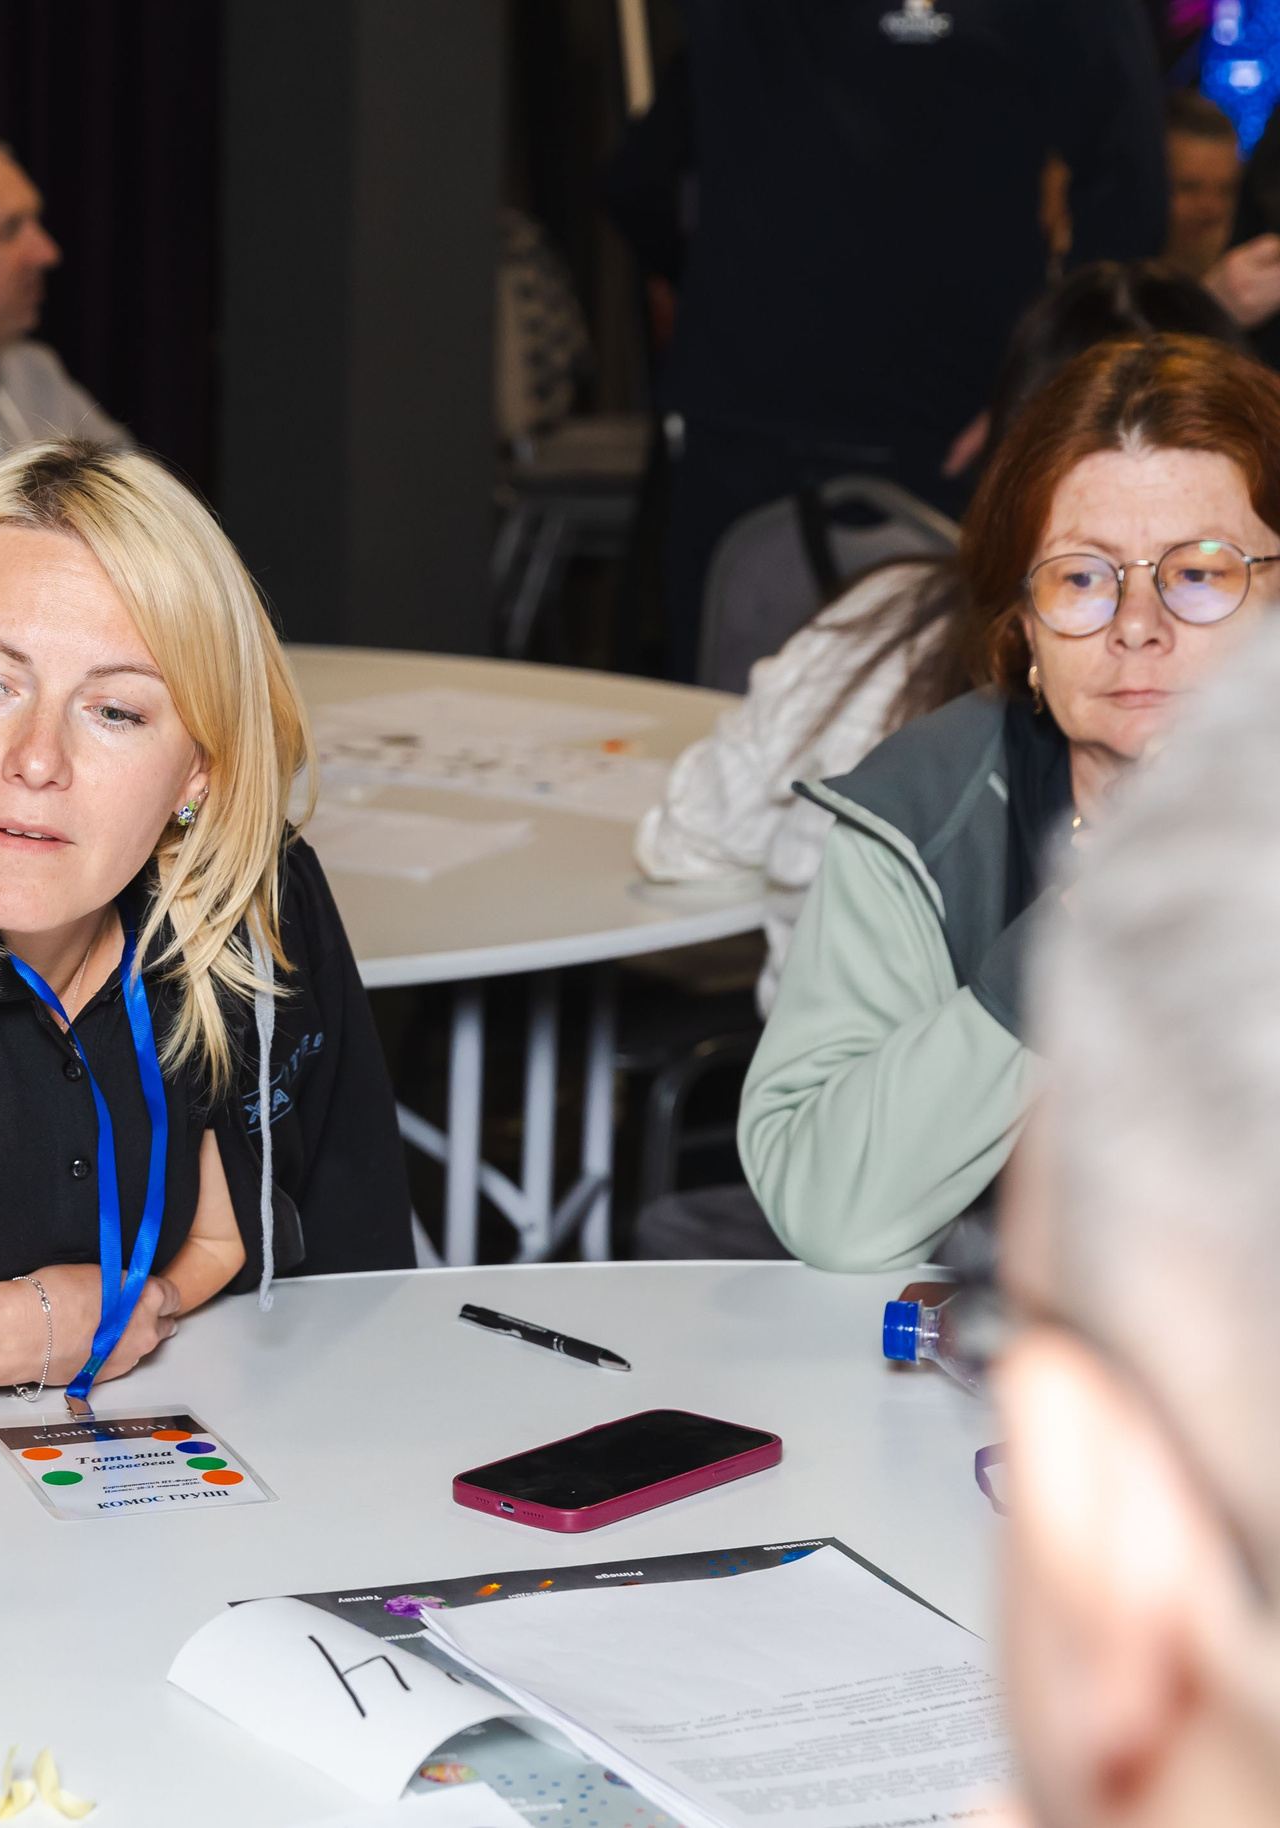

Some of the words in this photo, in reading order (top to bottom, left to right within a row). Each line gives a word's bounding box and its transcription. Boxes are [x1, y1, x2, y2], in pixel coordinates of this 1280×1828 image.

[108, 1425, 125, 1433] IT
[131, 1424, 167, 1432] DAY
[75, 1450, 173, 1465] Татьяна
[92, 1459, 175, 1472] Медведева
[96, 1494, 164, 1510] КОМОС
[168, 1489, 231, 1501] ГРУПП
[762, 1541, 824, 1551] Homebase
